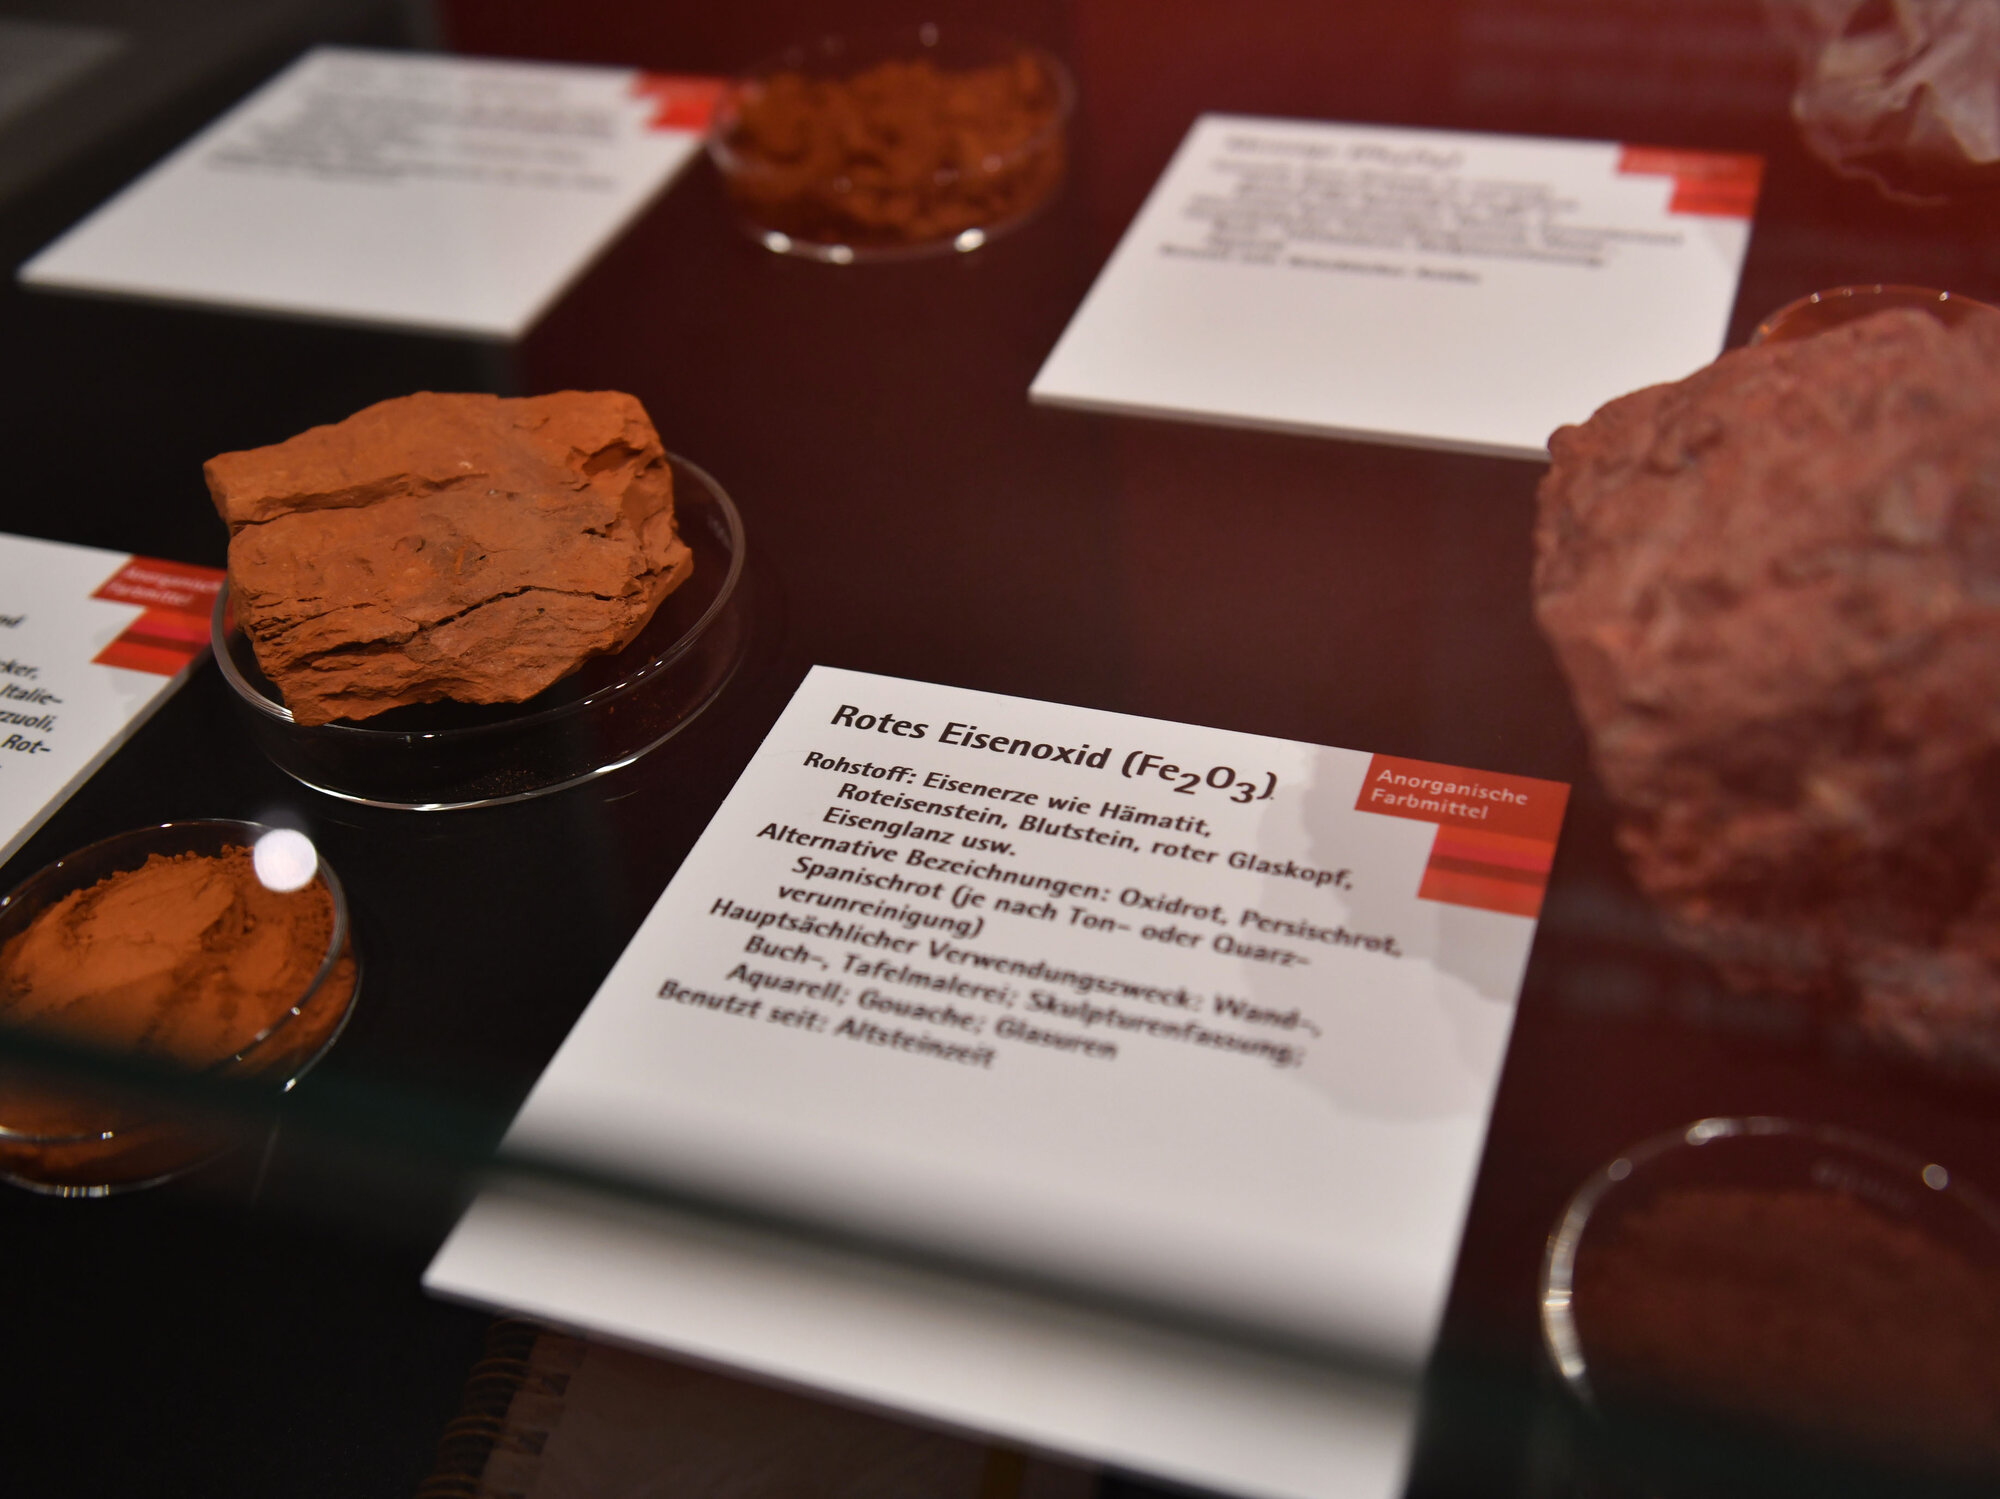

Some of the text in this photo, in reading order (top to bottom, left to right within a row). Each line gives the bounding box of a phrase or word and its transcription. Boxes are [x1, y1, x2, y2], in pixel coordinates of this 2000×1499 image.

[830, 704, 929, 740] Rotes
[938, 721, 1112, 770] Eisenoxid
[803, 751, 1212, 838] Rohstoff: Eisenerze wie Hämatit,
[822, 806, 1017, 857] Eisenglanz usw.
[1370, 787, 1489, 820] Farbmittel
[1376, 769, 1528, 806] Anorganische
[836, 782, 1355, 892] Roteisenstein, Blutstein, roter Glaskopf,
[756, 822, 1404, 958] Alternative Bezeichnungen: Oxidrot, Persischrot,
[778, 885, 985, 939] verunreinigung)
[791, 856, 943, 901] Spanischrot
[950, 883, 986, 909] (je
[994, 897, 1058, 922] nach
[1141, 923, 1203, 950] oder
[709, 897, 919, 955] Hauptsächlicher
[928, 940, 1204, 1012] Verwendungszweck:
[656, 978, 998, 1072] Benutzt seit: Altsteinzeit
[725, 962, 1119, 1061] Aquarell; Gouache; Glasuren
[842, 952, 1015, 1009] Tafelmalerei;
[1025, 989, 1307, 1068] Skulpturenfassung;
